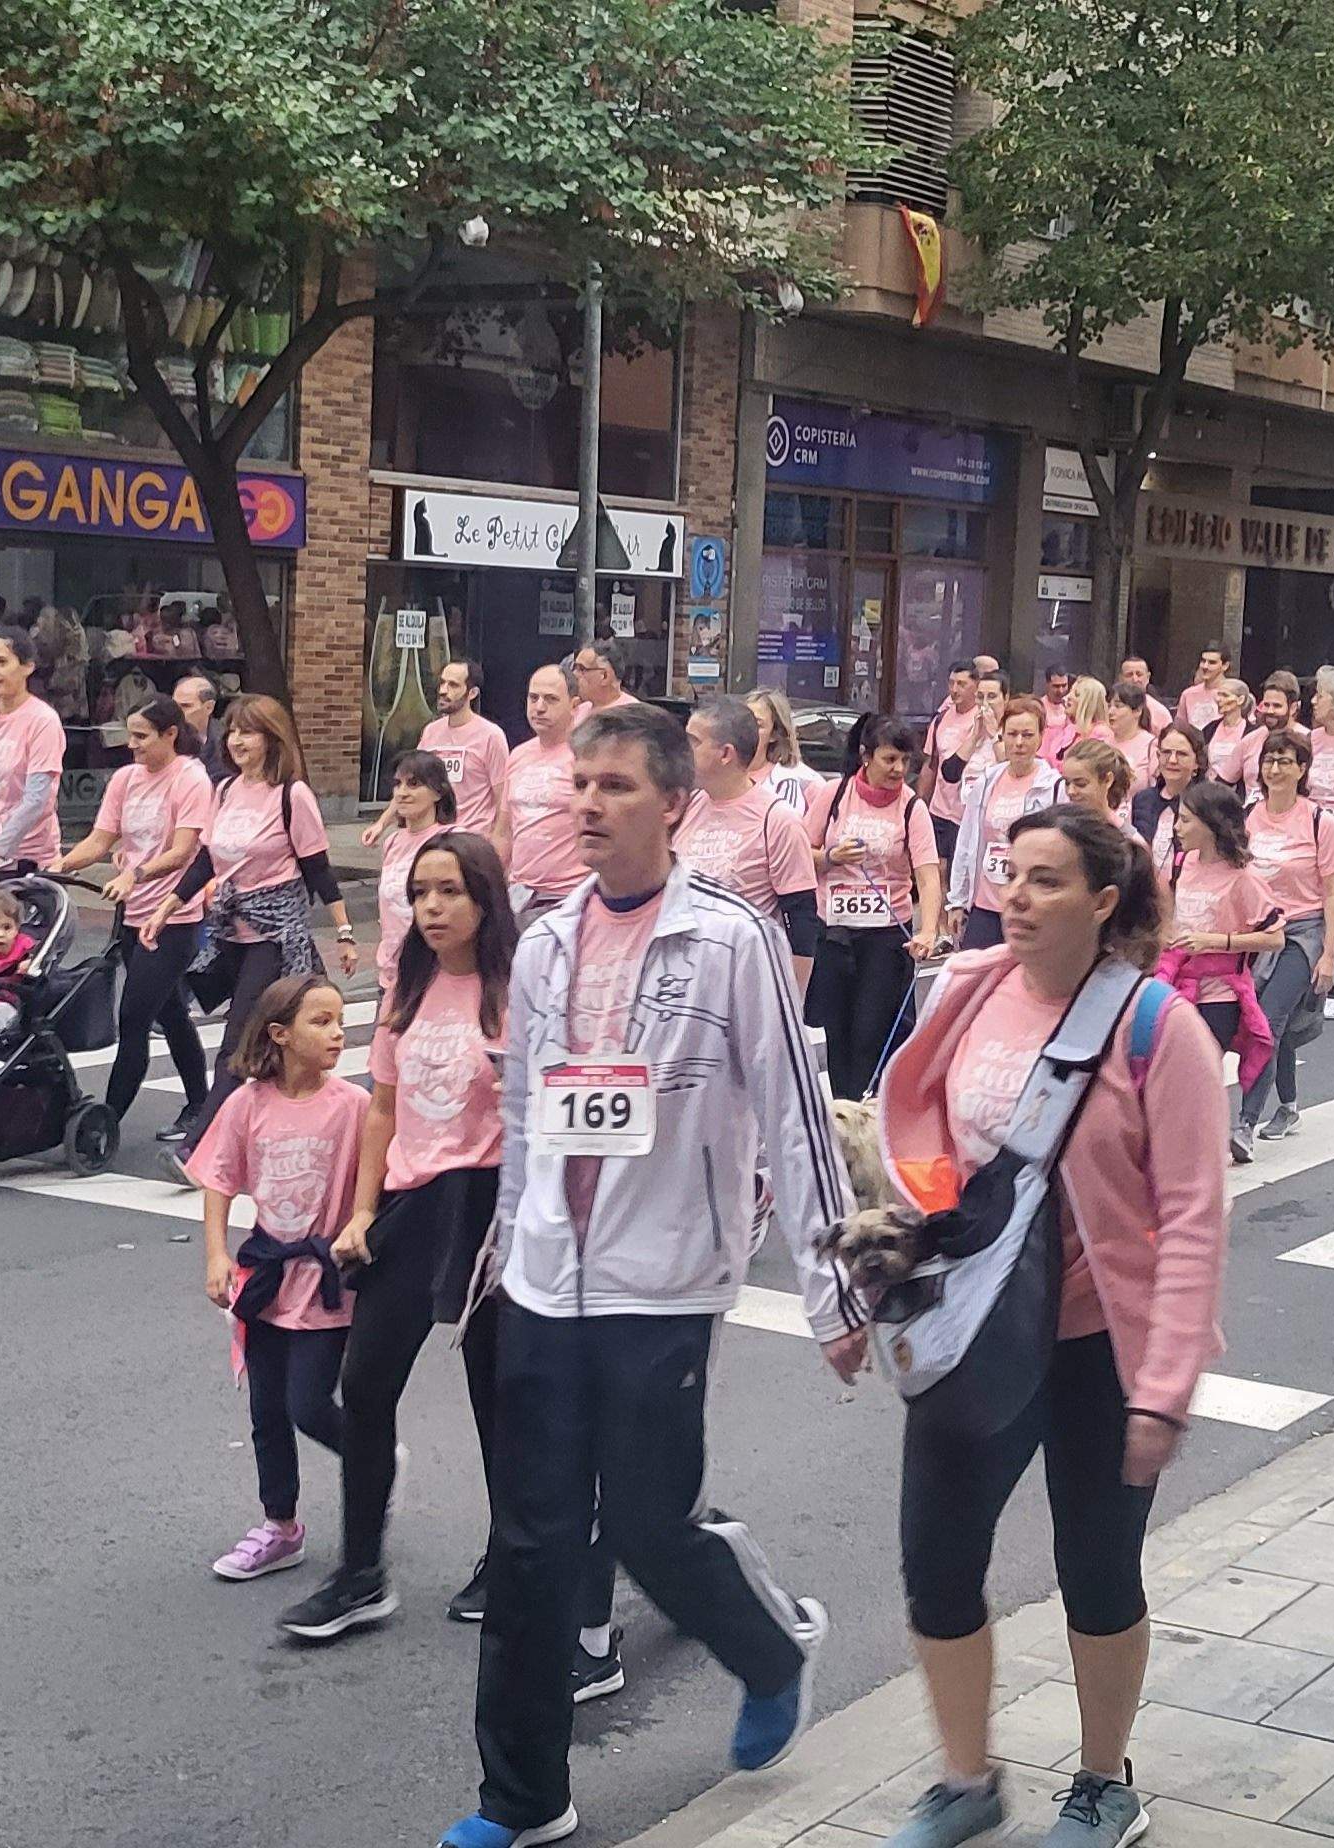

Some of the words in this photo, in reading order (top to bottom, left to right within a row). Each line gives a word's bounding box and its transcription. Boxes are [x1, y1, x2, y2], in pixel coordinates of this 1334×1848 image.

[794, 425, 857, 448] COPISTERÍA
[793, 447, 818, 465] CRM
[1, 460, 206, 532] GANGA
[454, 515, 481, 545] Le
[486, 514, 539, 551] Petit
[1240, 517, 1301, 562] VALLE
[405, 614, 425, 629] ALQUILA
[445, 758, 461, 773] 90
[987, 857, 1008, 873] 31
[833, 896, 886, 914] 3652
[560, 1092, 631, 1129] 169
